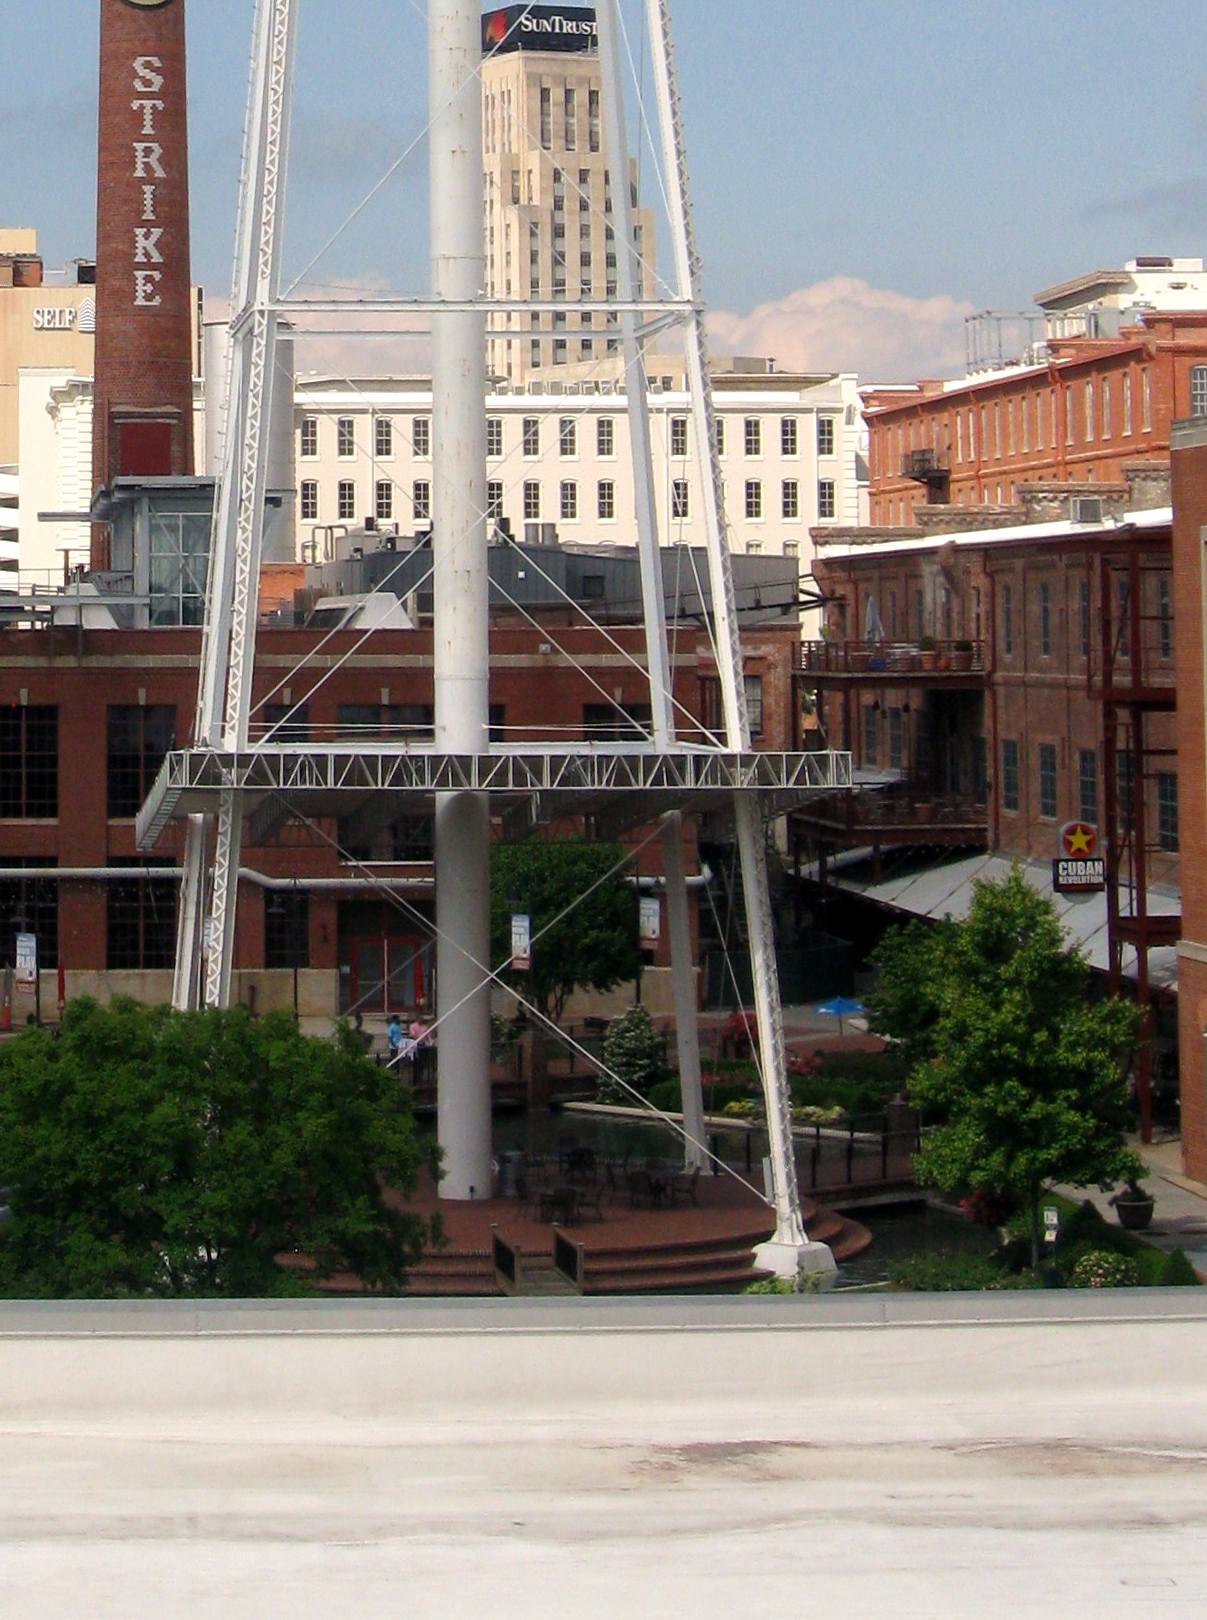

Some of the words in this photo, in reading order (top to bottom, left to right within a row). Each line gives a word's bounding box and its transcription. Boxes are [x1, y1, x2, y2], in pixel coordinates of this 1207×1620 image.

[131, 55, 167, 306] STRIKE
[33, 307, 76, 329] SELF
[1058, 861, 1103, 876] CUBAN
